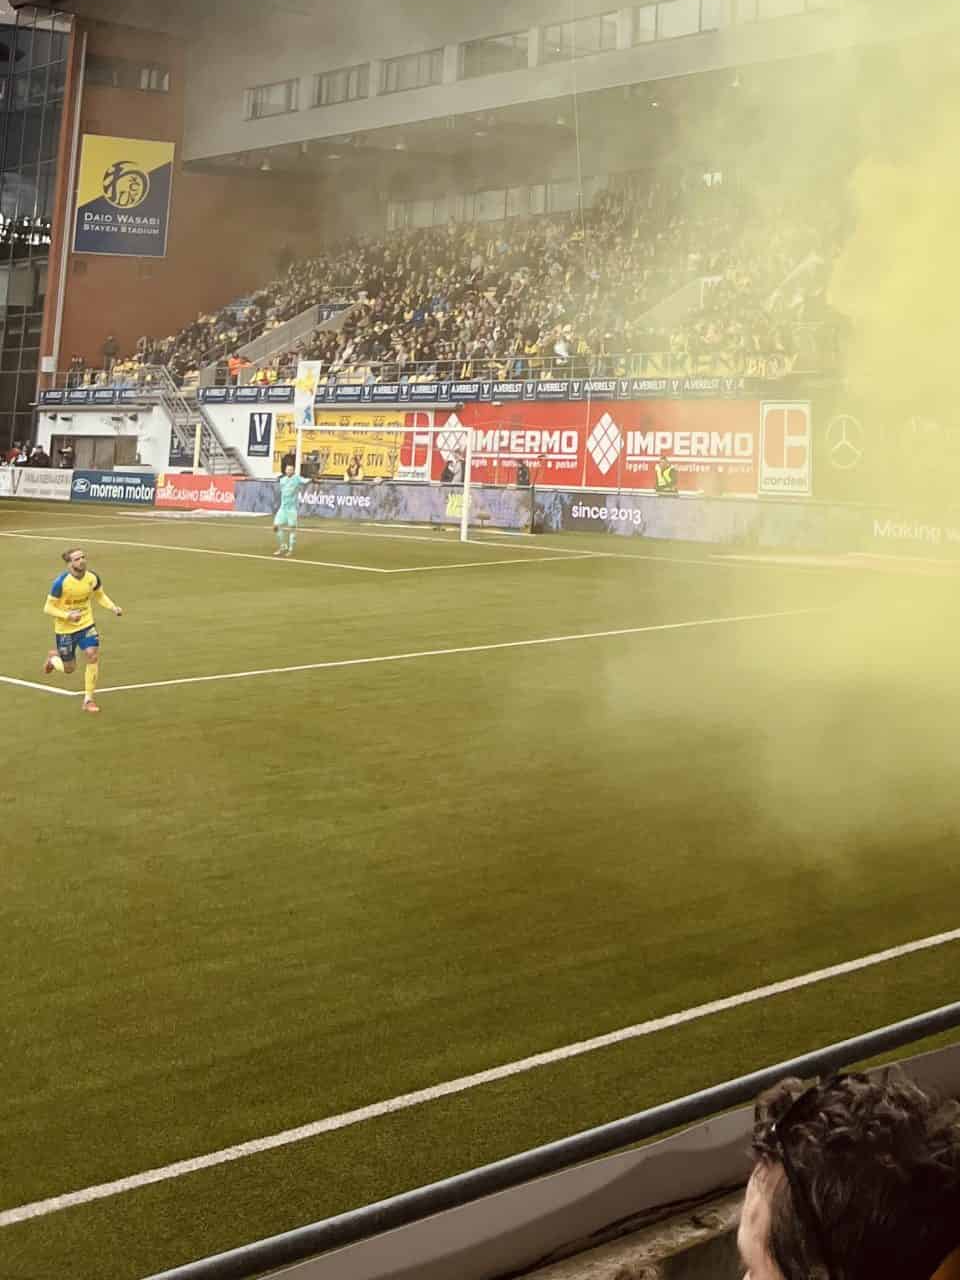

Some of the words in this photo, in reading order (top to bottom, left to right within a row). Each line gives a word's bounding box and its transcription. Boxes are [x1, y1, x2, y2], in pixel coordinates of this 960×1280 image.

[117, 214, 160, 225] WASABI
[474, 430, 578, 453] IMPERMO
[626, 431, 753, 456] IMPERMO
[89, 484, 124, 499] morren
[298, 491, 335, 509] Making
[336, 495, 371, 508] waves
[571, 501, 608, 519] since
[610, 507, 642, 524] 2013
